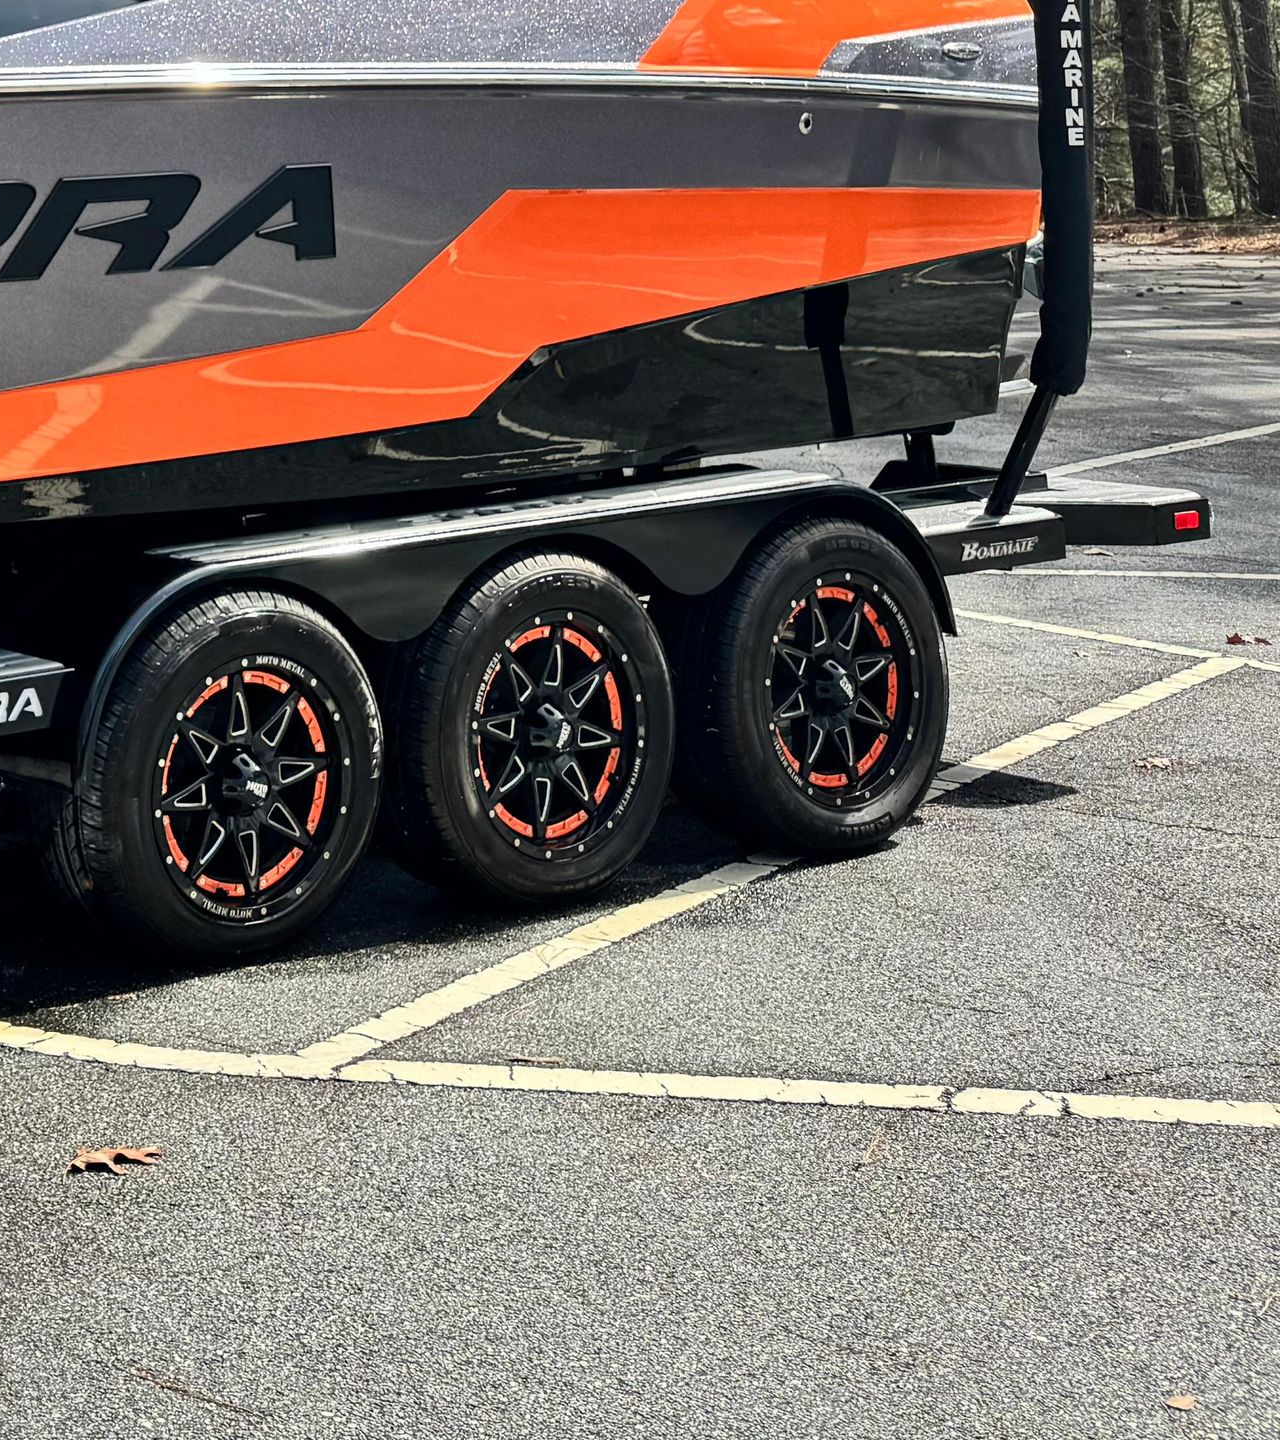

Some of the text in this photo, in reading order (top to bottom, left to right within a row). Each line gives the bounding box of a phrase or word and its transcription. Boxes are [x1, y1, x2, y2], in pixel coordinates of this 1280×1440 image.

[1060, 29, 1085, 147] MARINE
[961, 536, 1037, 562] BOATMATE
[255, 655, 305, 678] MOTO METAL
[473, 652, 503, 712] MOTO METAL
[615, 756, 642, 816] MOTO METAL
[202, 898, 253, 919] MOTO METAL
